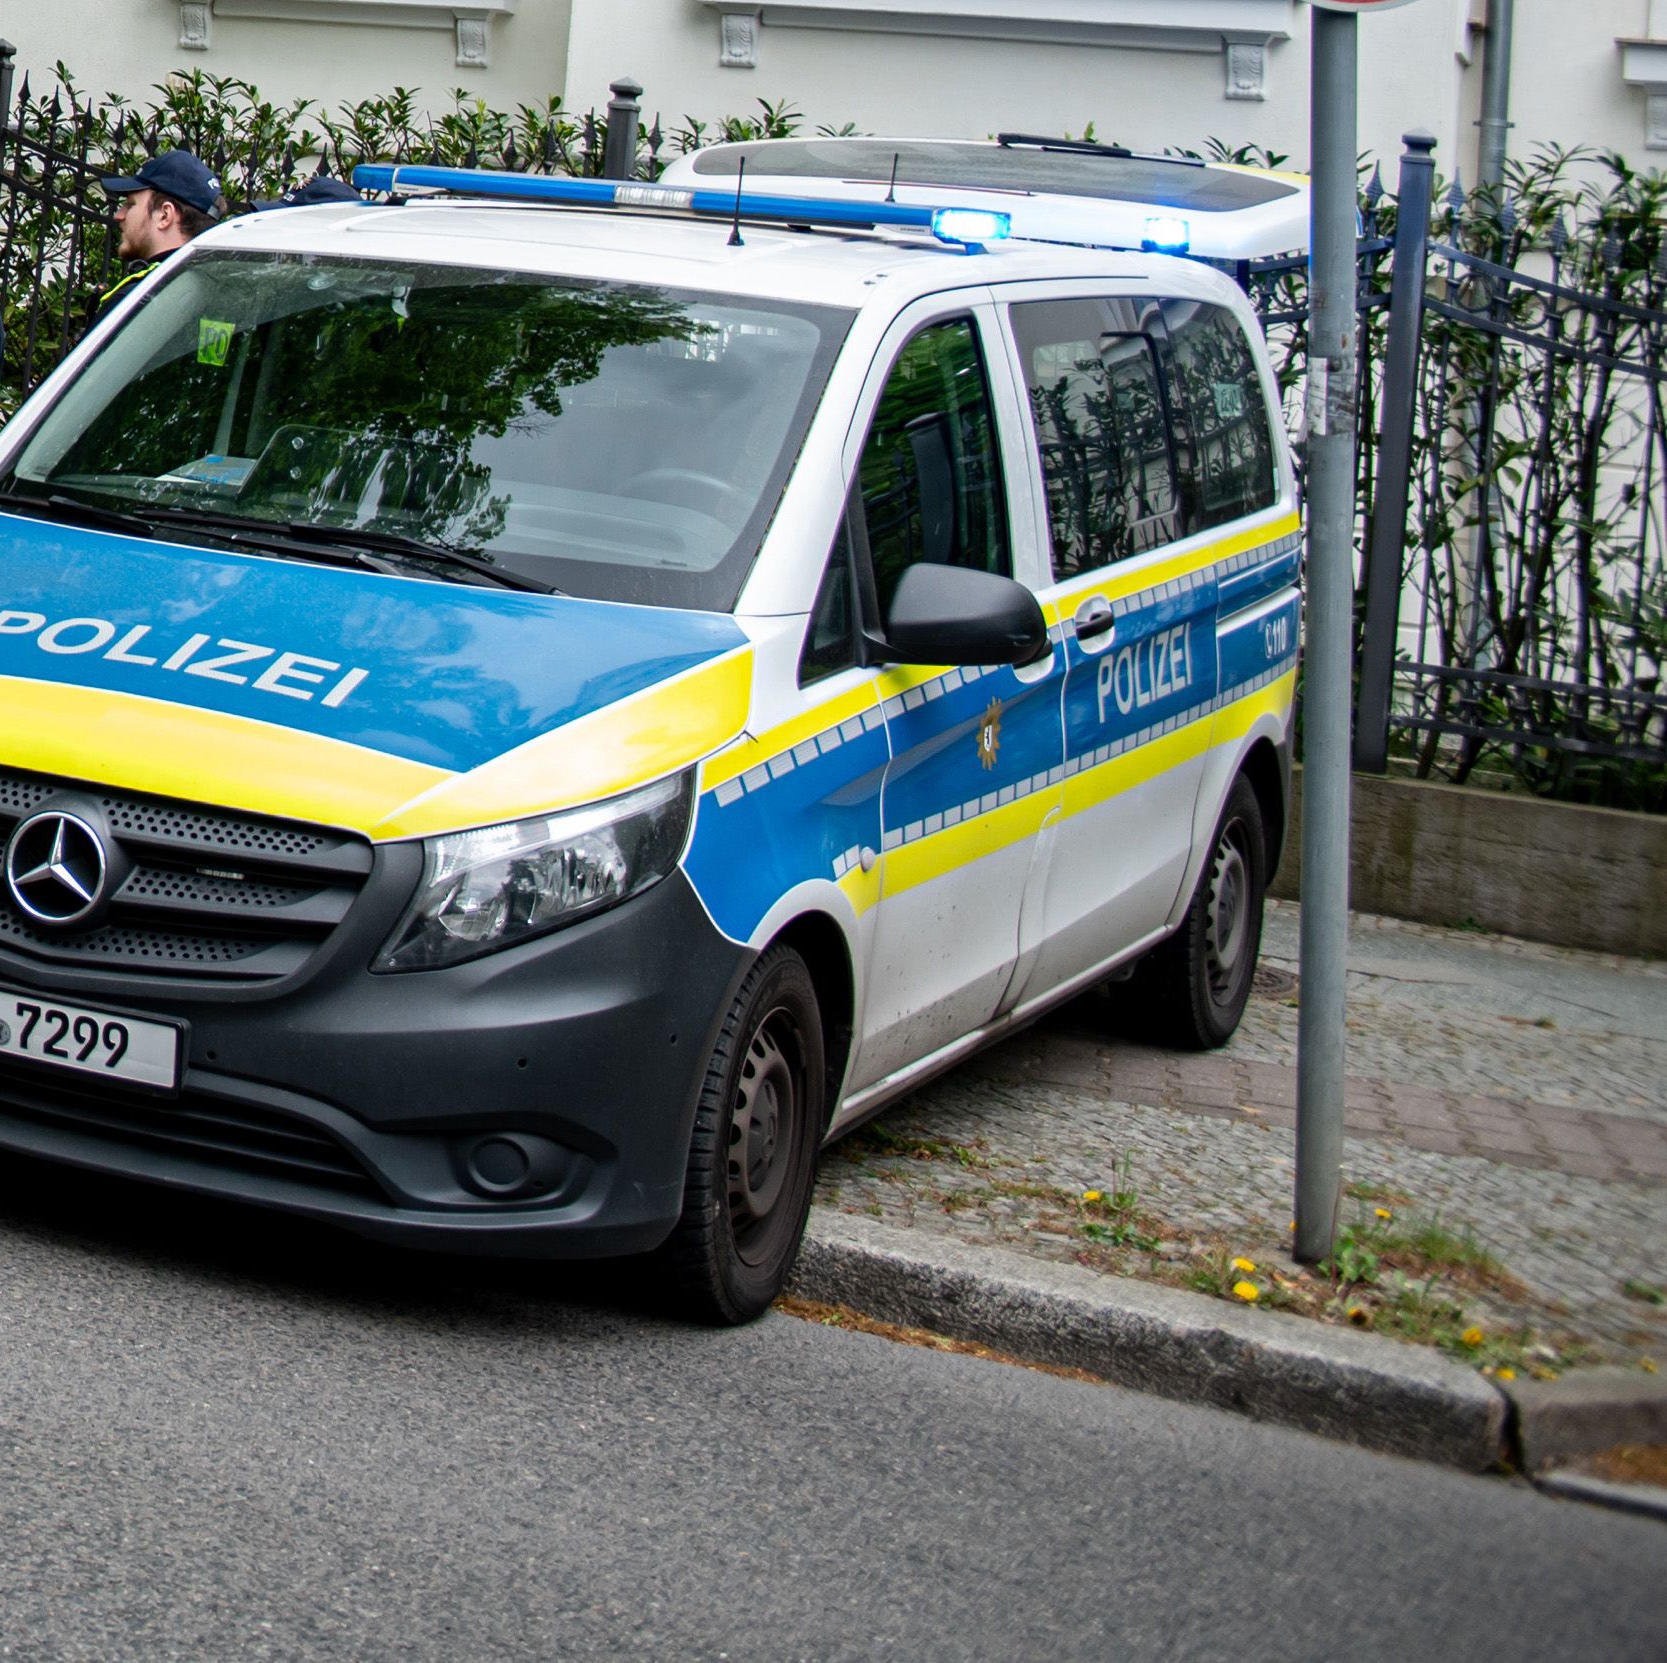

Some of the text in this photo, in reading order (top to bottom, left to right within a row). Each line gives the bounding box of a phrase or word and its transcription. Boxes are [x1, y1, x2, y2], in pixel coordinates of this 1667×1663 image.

[1272, 616, 1287, 656] 110
[1097, 622, 1192, 724] POLIZEI
[17, 1001, 129, 1068] 7299
